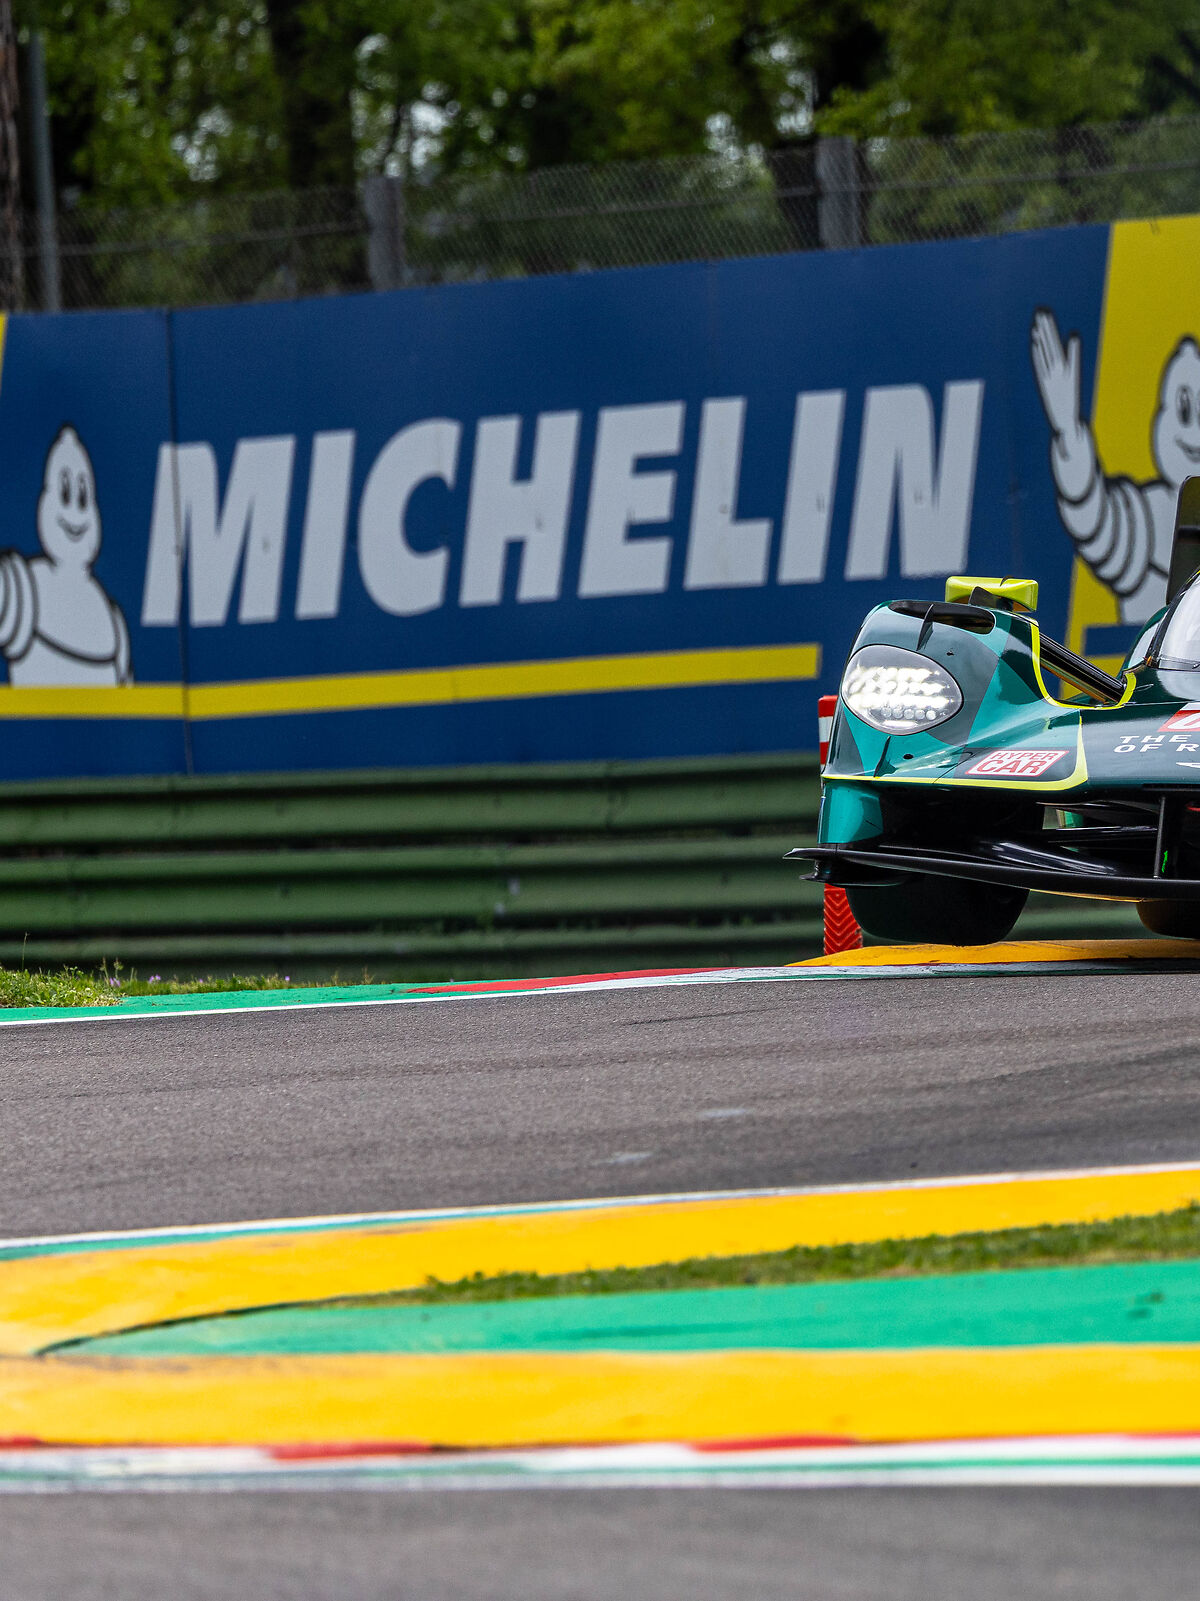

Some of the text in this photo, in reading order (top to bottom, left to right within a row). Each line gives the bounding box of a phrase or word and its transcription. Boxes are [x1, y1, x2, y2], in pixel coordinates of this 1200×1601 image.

[140, 379, 984, 627] MICHELIN
[1119, 734, 1192, 744] THE
[1114, 743, 1163, 753] OF
[990, 752, 1058, 760] HYPER
[976, 760, 1047, 773] CAR
